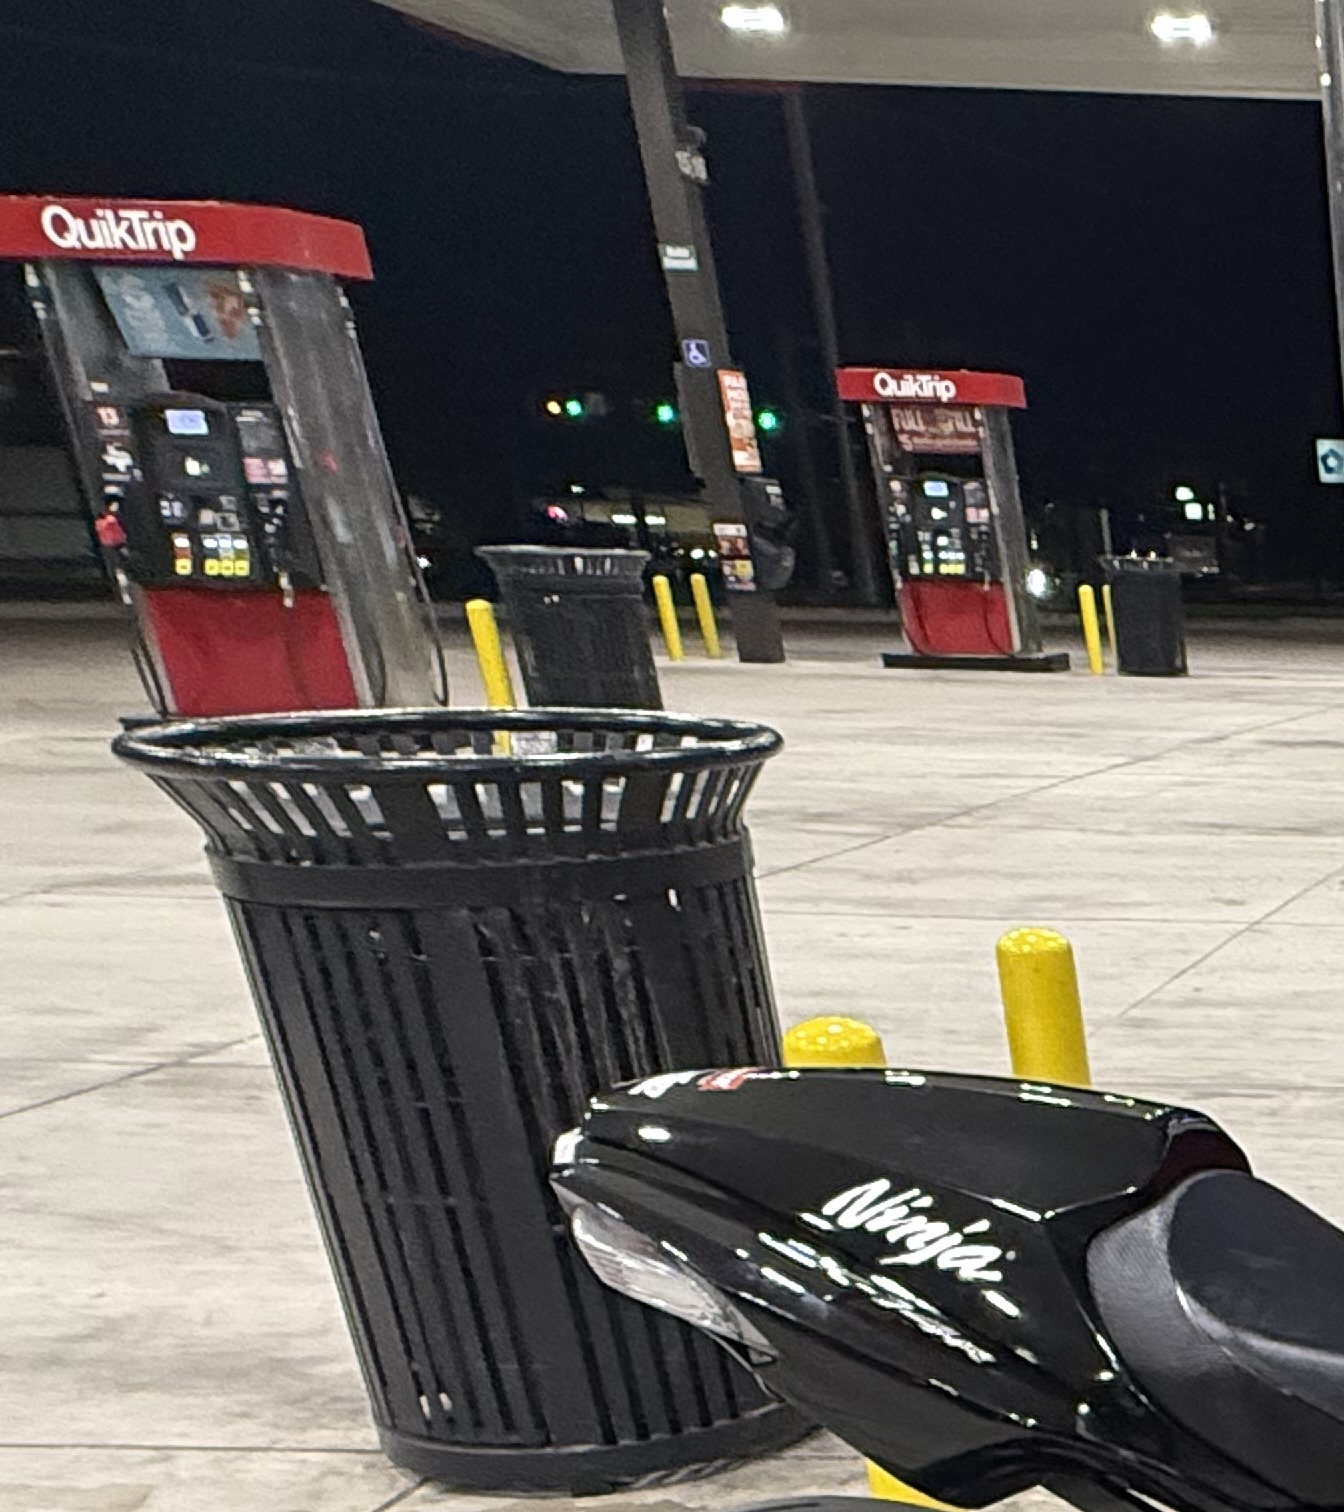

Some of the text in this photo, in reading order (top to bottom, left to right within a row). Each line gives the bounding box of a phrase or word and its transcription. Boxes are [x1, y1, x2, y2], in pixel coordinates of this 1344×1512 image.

[41, 205, 196, 260] QuikTrip
[873, 372, 957, 403] QuikTrip
[822, 1178, 1002, 1282] Ninja
